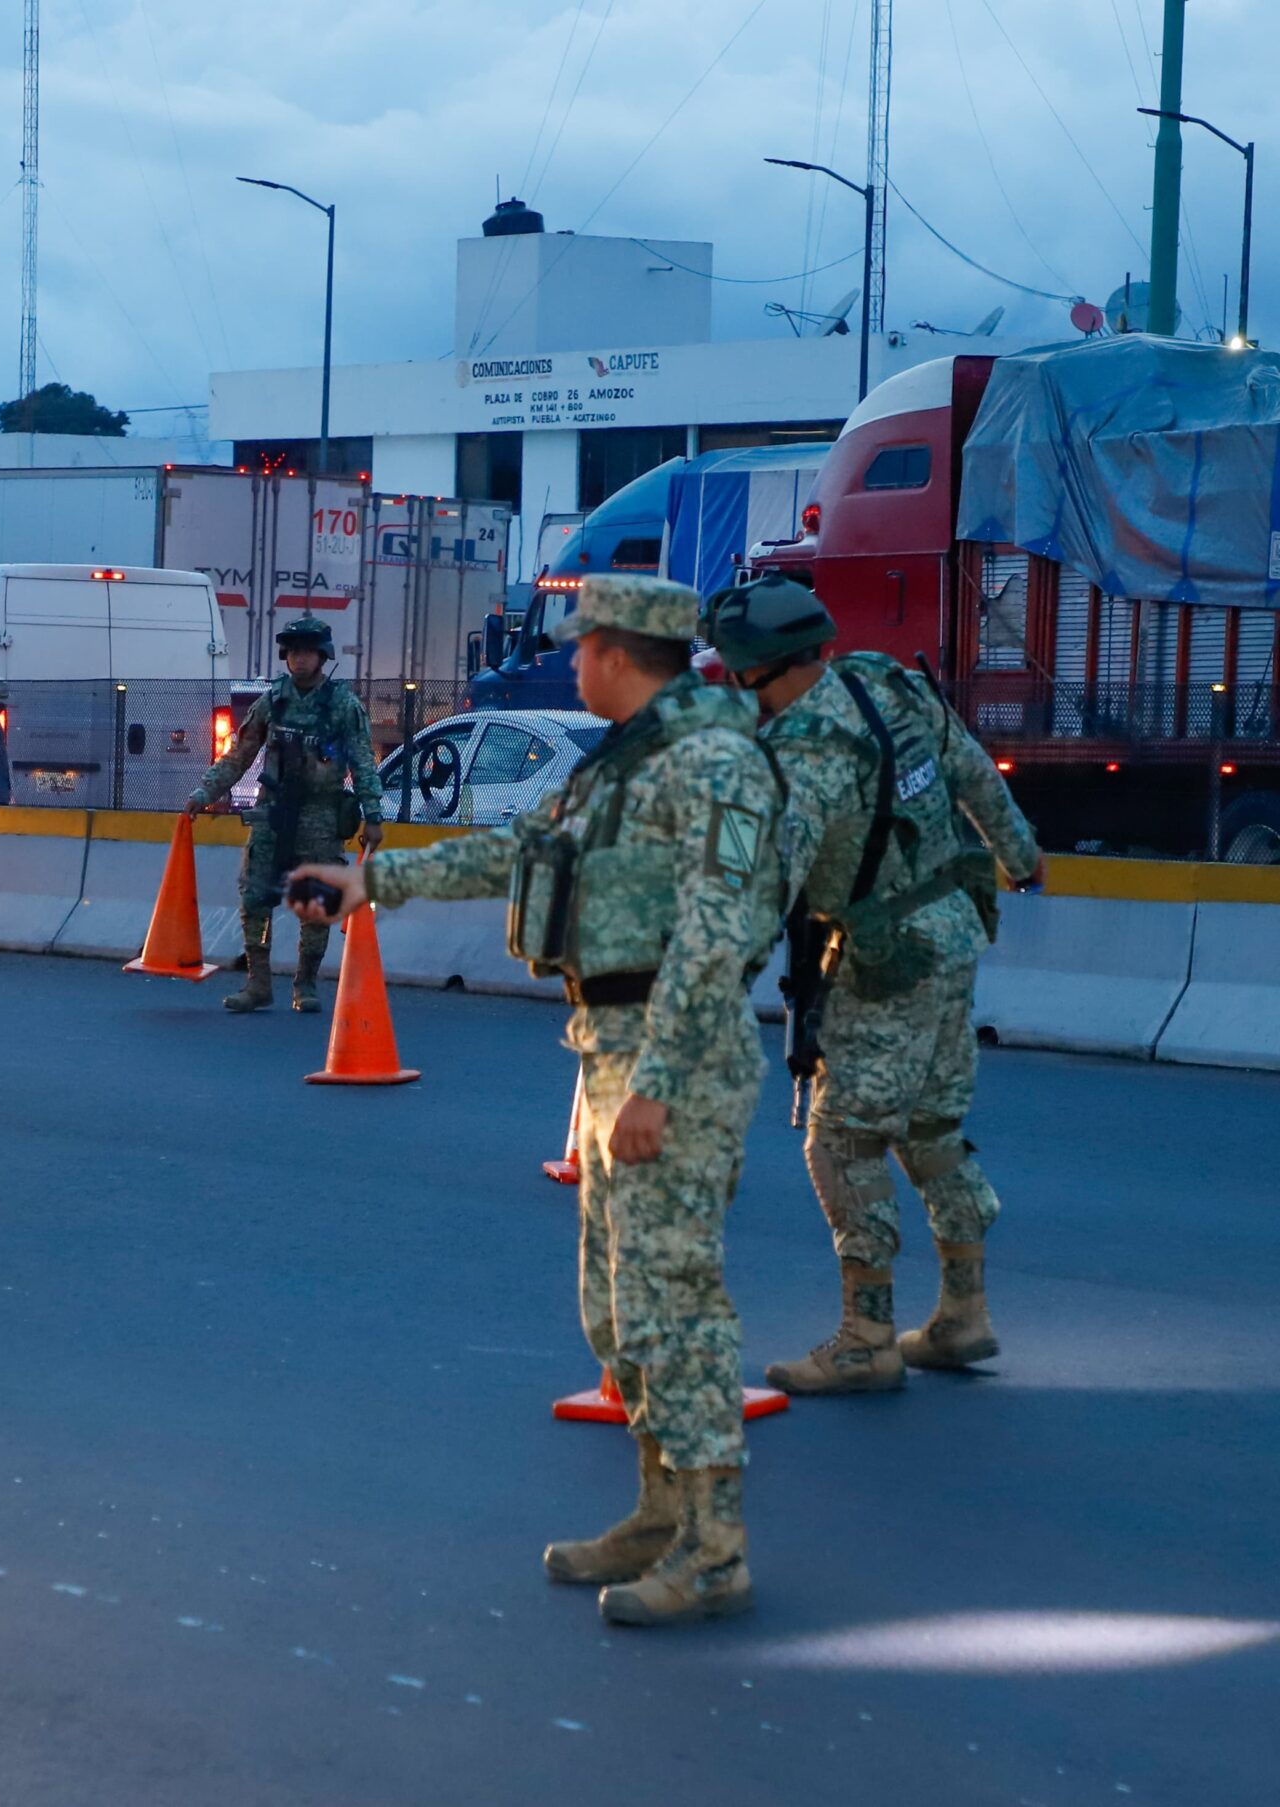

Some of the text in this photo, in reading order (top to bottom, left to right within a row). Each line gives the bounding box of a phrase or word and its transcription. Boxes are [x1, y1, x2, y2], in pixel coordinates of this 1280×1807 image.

[472, 359, 552, 378] COMUNICACIONES
[609, 352, 659, 370] CAPUFE
[484, 387, 635, 405] PLAZA DE COBRO 26 AMOZOC
[530, 404, 544, 413] KM
[531, 414, 562, 424] PUEBLA
[313, 508, 358, 537] 170
[478, 527, 495, 541] 24
